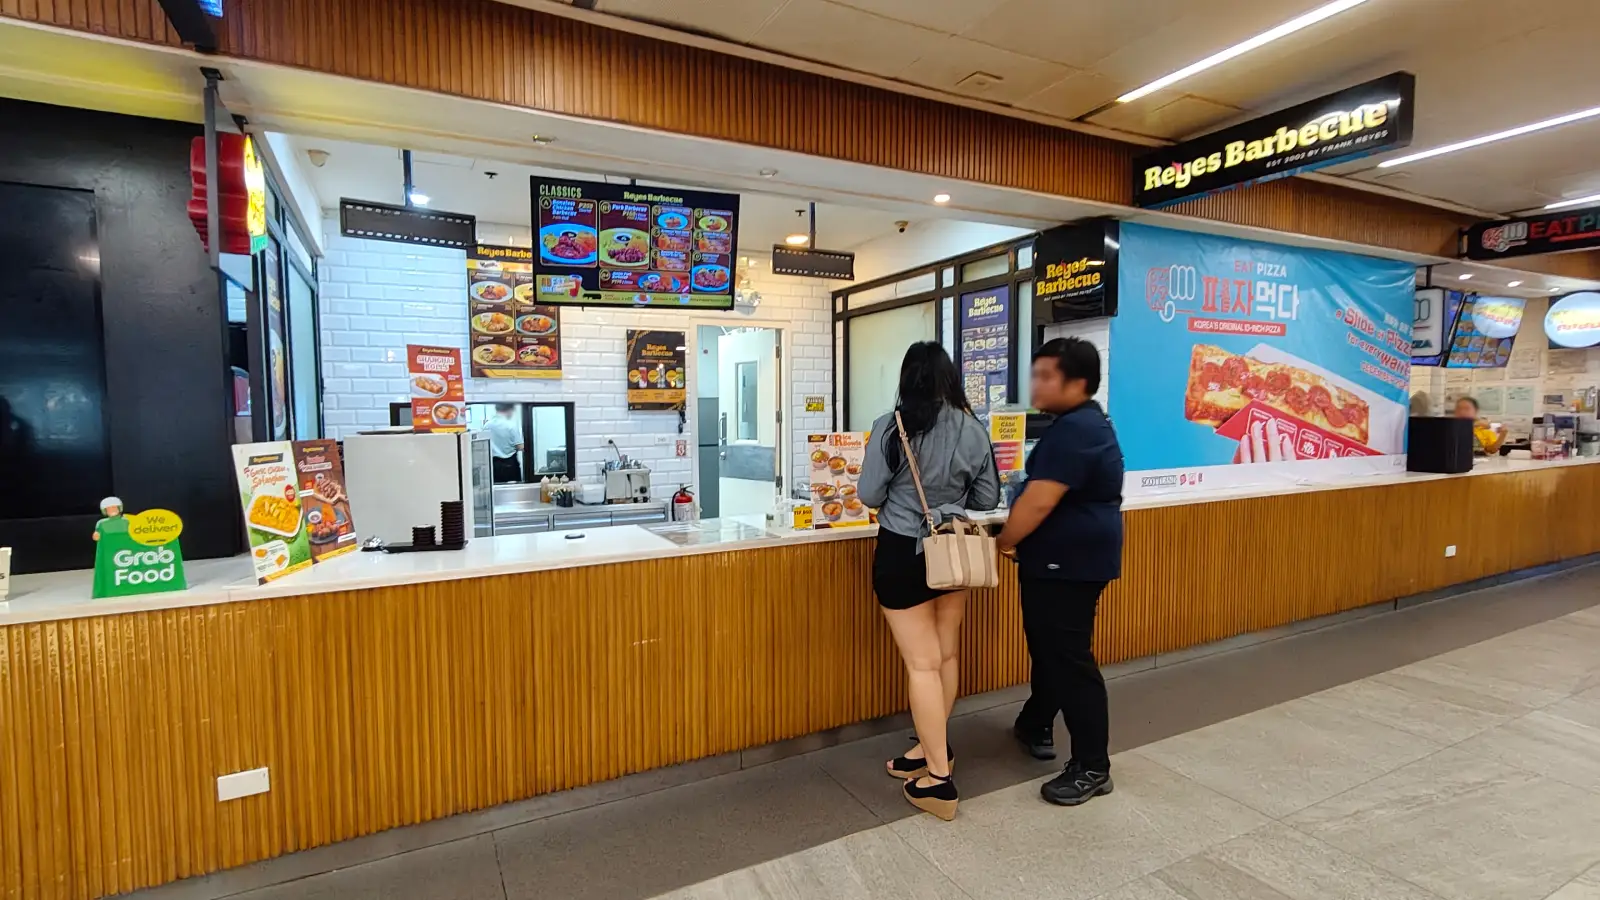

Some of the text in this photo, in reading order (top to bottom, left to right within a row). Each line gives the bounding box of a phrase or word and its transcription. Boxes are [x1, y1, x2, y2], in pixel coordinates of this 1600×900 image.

[1143, 103, 1388, 191] Reyes Barbecue
[1266, 159, 1282, 168] EST
[1307, 148, 1320, 157] BY
[1321, 140, 1353, 154] FRANK
[1354, 129, 1388, 145] REYES
[540, 184, 582, 198] CLASSICS
[624, 191, 683, 204] Reyes Barbecue
[624, 204, 648, 212] Barbecue
[477, 246, 532, 259] Reyes Barbe
[1045, 257, 1088, 279] Reyes
[1234, 260, 1287, 278] EAT PIZZA
[1036, 272, 1101, 296] Barbecue
[974, 296, 997, 308] Reyes
[968, 304, 1004, 317] Barbecue
[1193, 319, 1219, 330] KOREA'S
[1219, 321, 1244, 332] ORIGINAL
[1266, 324, 1281, 334] PIZZA
[1347, 332, 1359, 345] for
[416, 355, 455, 365] SHANGHAI
[147, 516, 166, 524] We
[113, 547, 175, 568] Grab
[115, 564, 175, 586] Food
